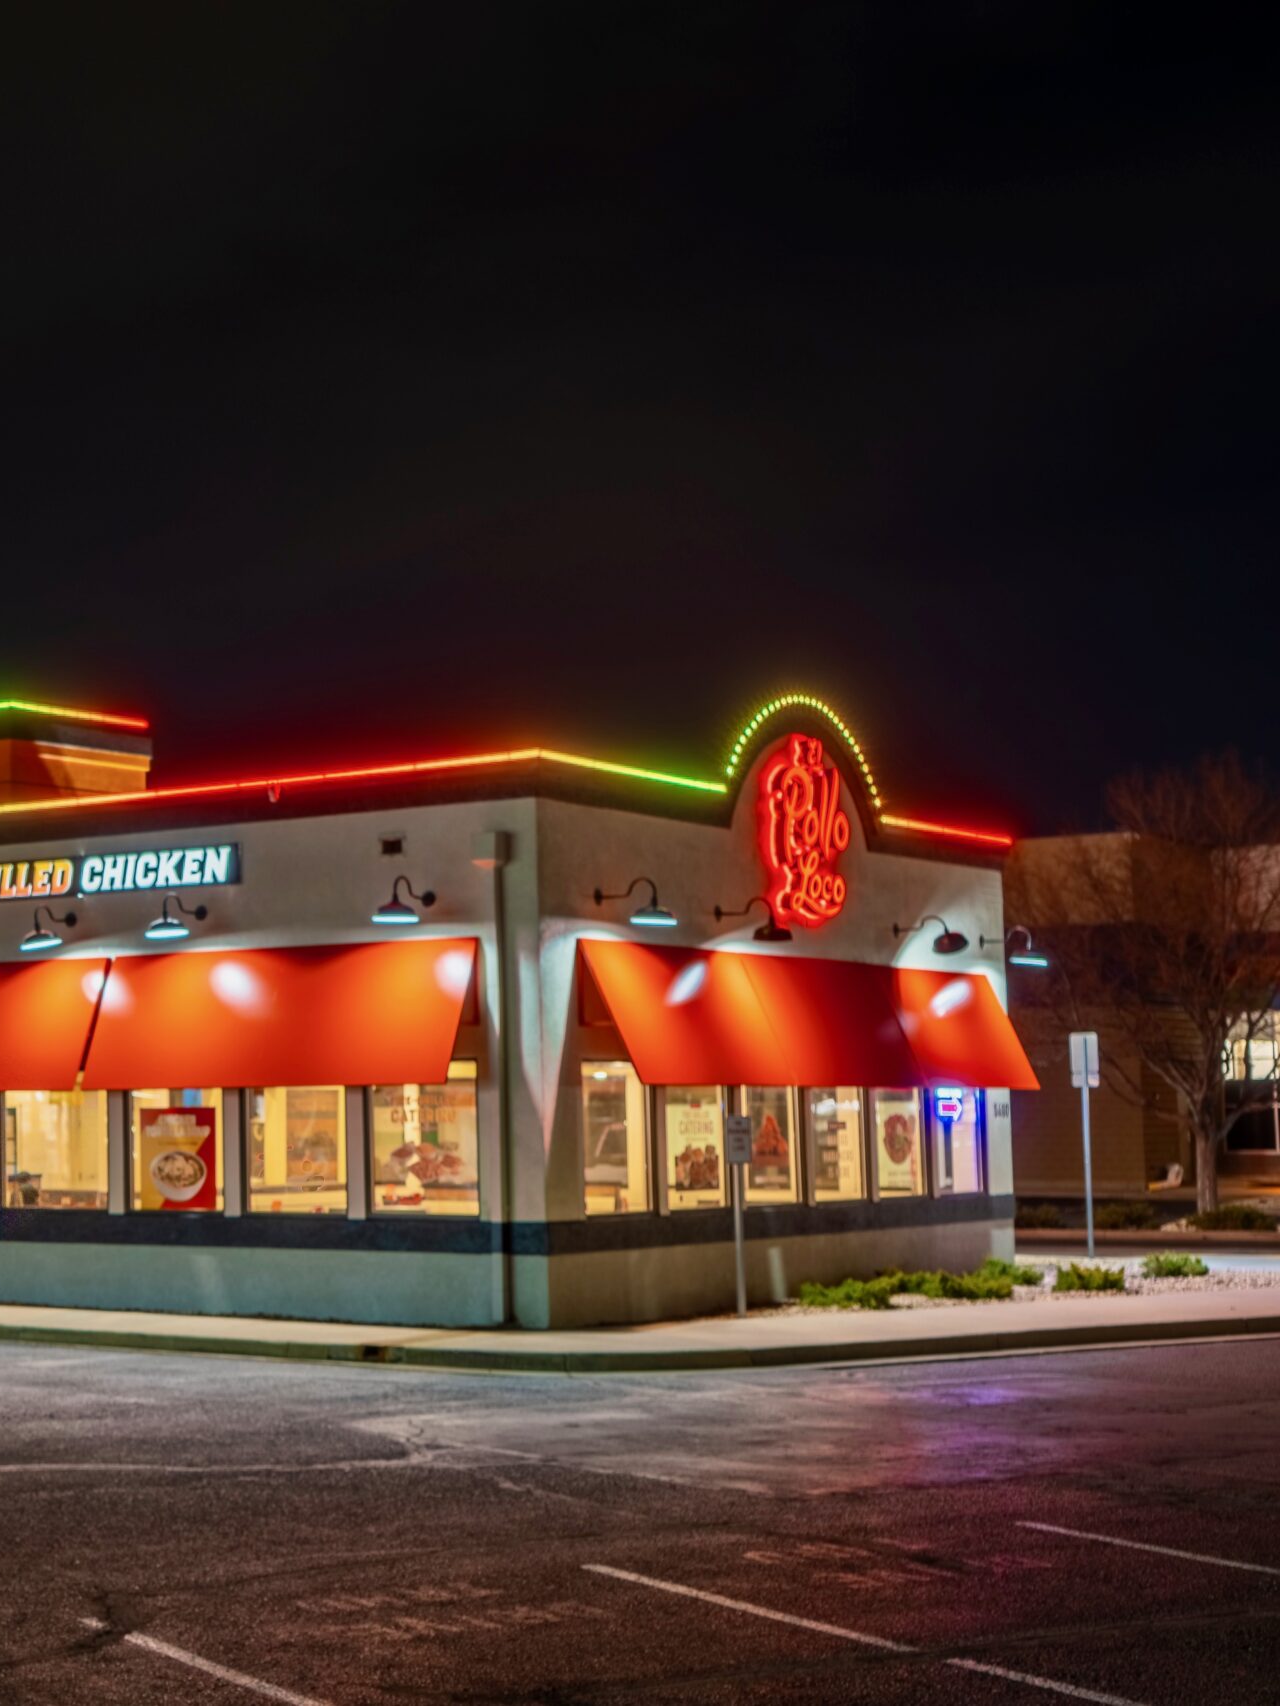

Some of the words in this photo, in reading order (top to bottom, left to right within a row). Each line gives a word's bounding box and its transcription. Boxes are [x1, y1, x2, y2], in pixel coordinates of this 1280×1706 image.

[782, 765, 850, 865] Pollo
[81, 845, 232, 893] CHICKEN
[791, 850, 846, 914] Loco
